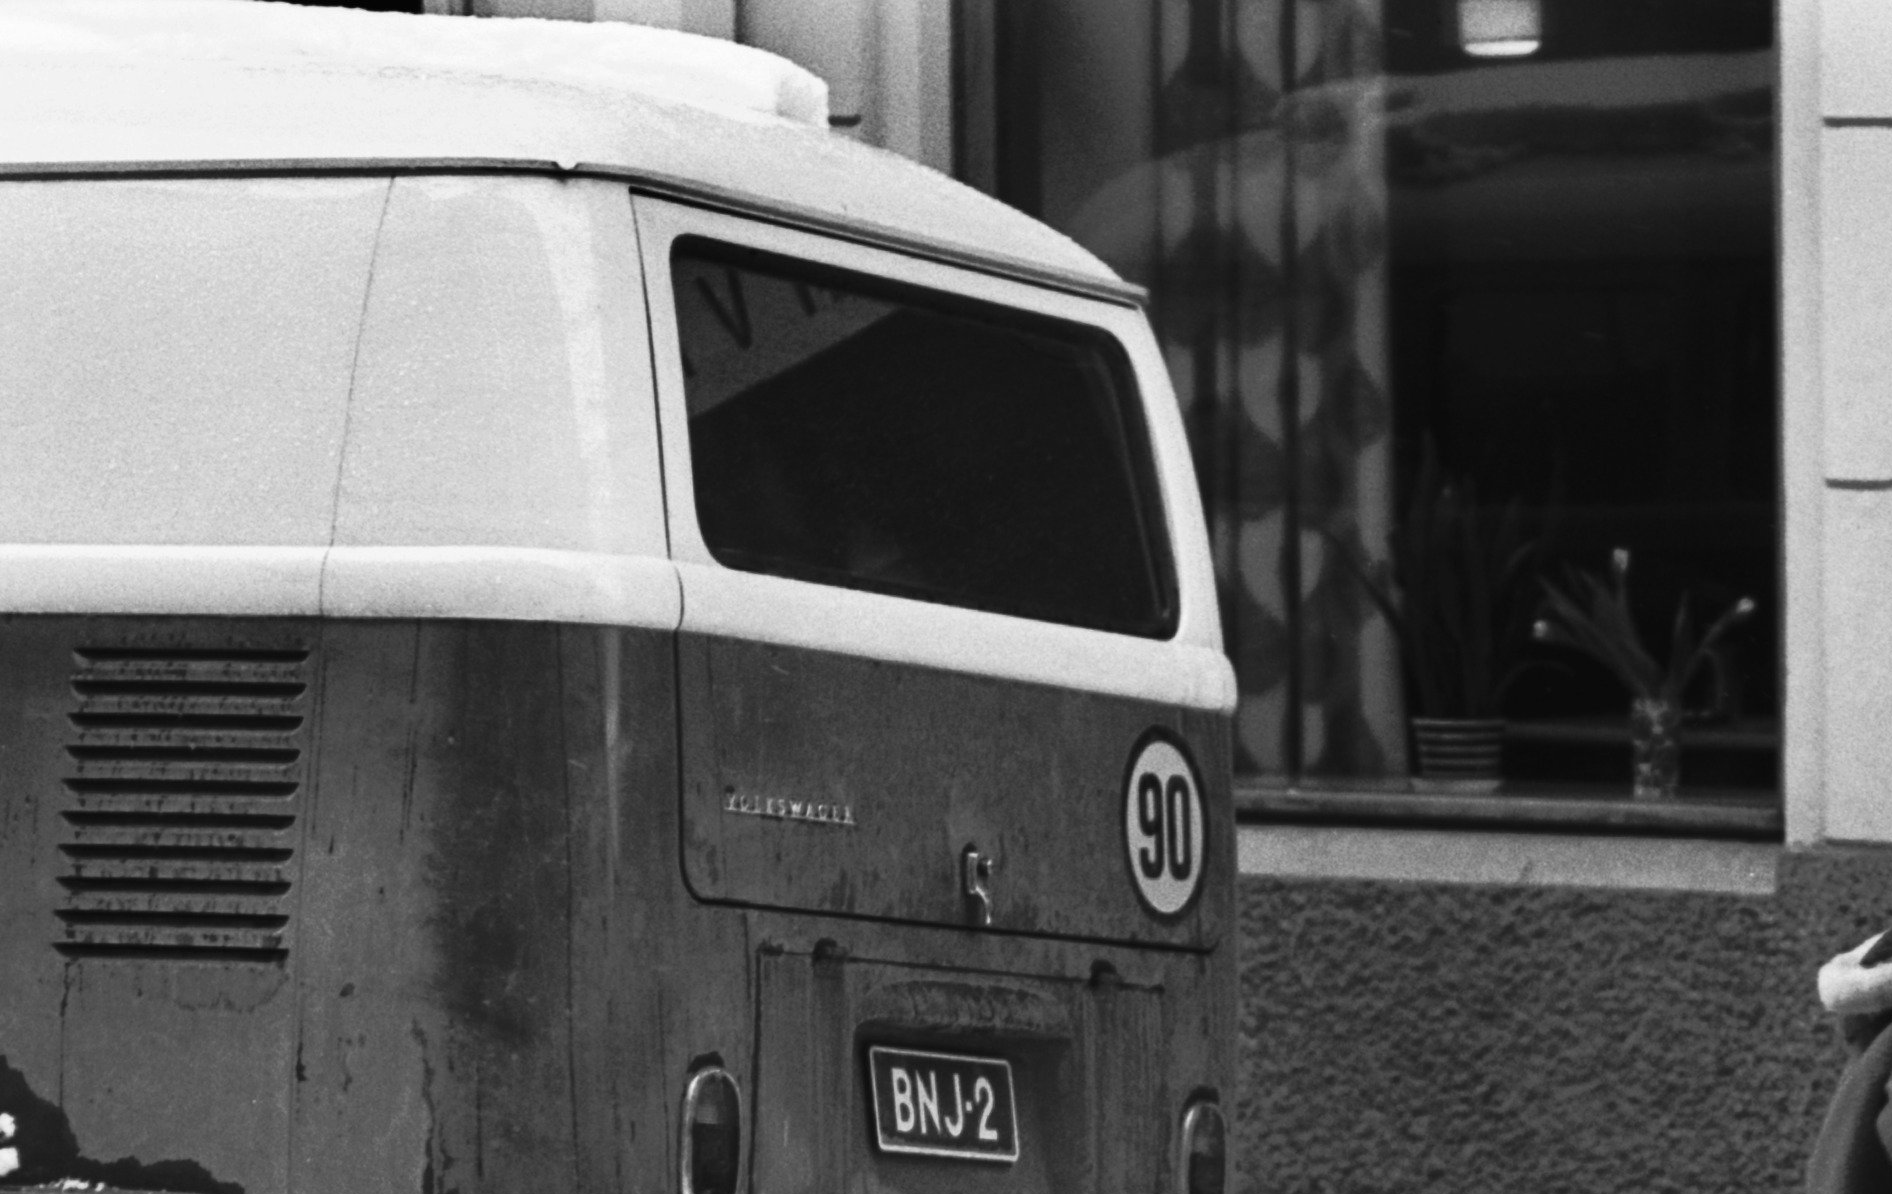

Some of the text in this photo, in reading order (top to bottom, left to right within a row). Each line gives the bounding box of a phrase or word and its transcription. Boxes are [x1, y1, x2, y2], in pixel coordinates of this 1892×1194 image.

[725, 793, 855, 825] VOLKSWAGEN
[1137, 772, 1193, 882] 90
[890, 1067, 998, 1140] BNJ-2
